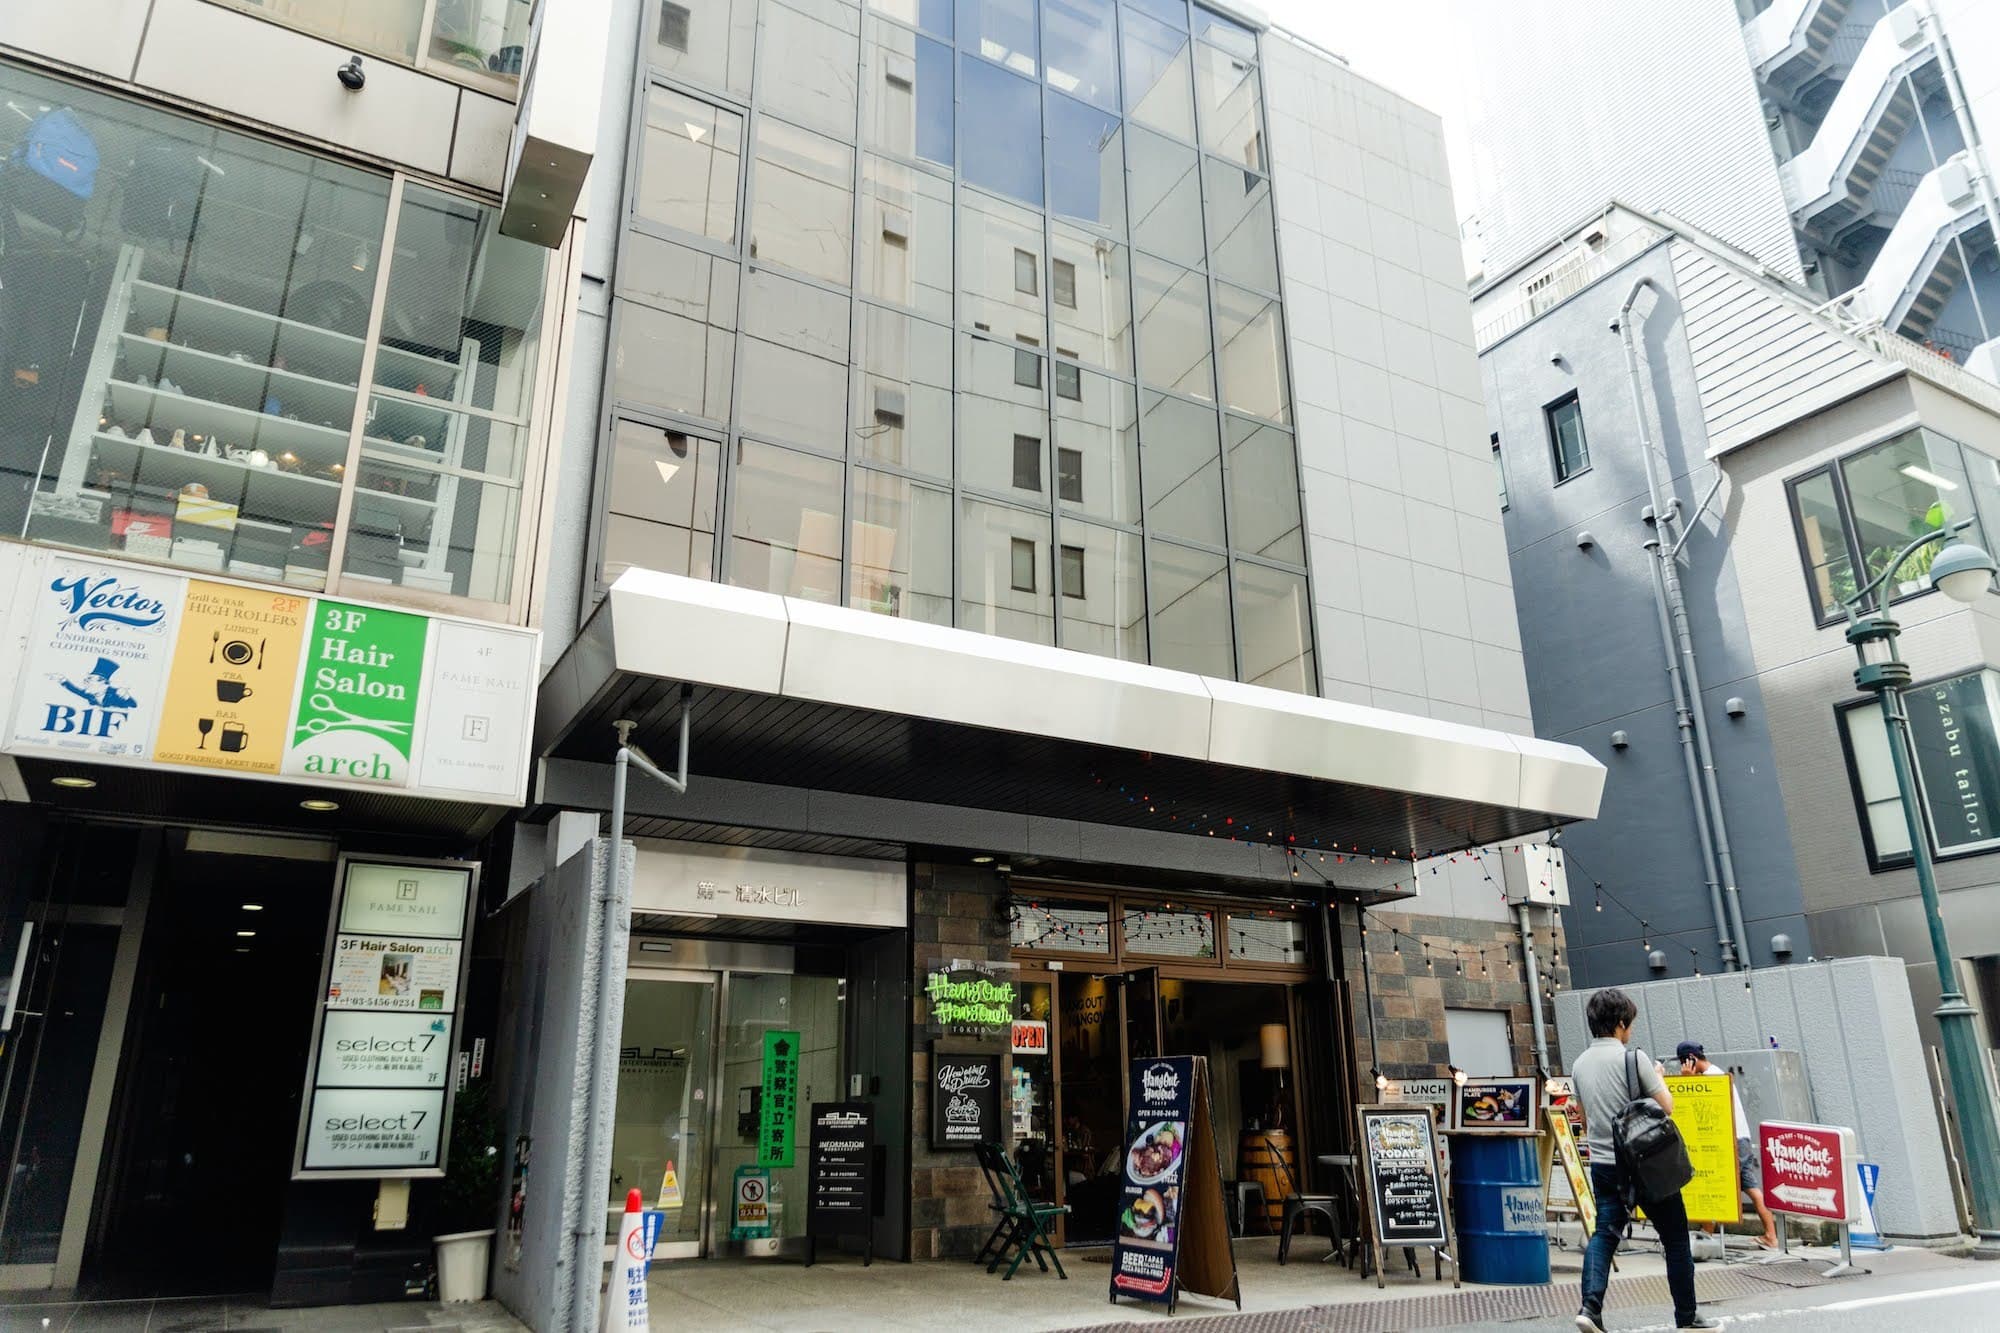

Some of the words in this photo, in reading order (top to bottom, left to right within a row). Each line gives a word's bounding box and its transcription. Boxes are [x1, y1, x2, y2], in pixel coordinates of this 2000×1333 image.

[51, 576, 165, 626] Vector
[188, 592, 208, 604] Grill
[223, 598, 245, 608] BAR
[271, 597, 300, 613] 2F
[189, 602, 230, 617] HIGH
[234, 609, 298, 627] ROLLERS
[324, 609, 367, 633] 3F
[224, 624, 260, 635] LUNCH
[56, 633, 145, 650] UNDERGROUND
[50, 641, 111, 656] CLOTHING
[112, 649, 149, 661] STORE
[320, 637, 395, 668] Hair
[223, 671, 243, 680] TEA
[315, 667, 406, 700] Salon
[441, 671, 481, 685] FAME
[486, 677, 521, 690] NAIL
[40, 703, 128, 738] B1F
[215, 710, 238, 719] BAR
[470, 719, 483, 737] F
[304, 753, 392, 781] arch
[1936, 691, 1961, 757] azabu
[1955, 768, 1981, 836] tailor
[402, 883, 414, 897] F
[697, 881, 804, 907] 第一清水ビル
[369, 902, 404, 914] FAME
[409, 905, 439, 915] NAIL
[341, 939, 358, 950] 3F
[360, 941, 387, 952] Hair
[389, 942, 424, 954] Salon
[425, 943, 453, 955] arch
[336, 1034, 436, 1053] select7
[1012, 1026, 1045, 1048] OPEN
[428, 1072, 439, 1082] 2F
[1403, 1084, 1446, 1095] LUNCH
[1668, 1084, 1713, 1094] COHOL
[770, 1059, 788, 1161] 警察官立寄所
[325, 1111, 428, 1131] select7
[819, 1140, 865, 1148] INFORMATION
[419, 1150, 430, 1161] 1F
[1122, 1251, 1144, 1267] BEER
